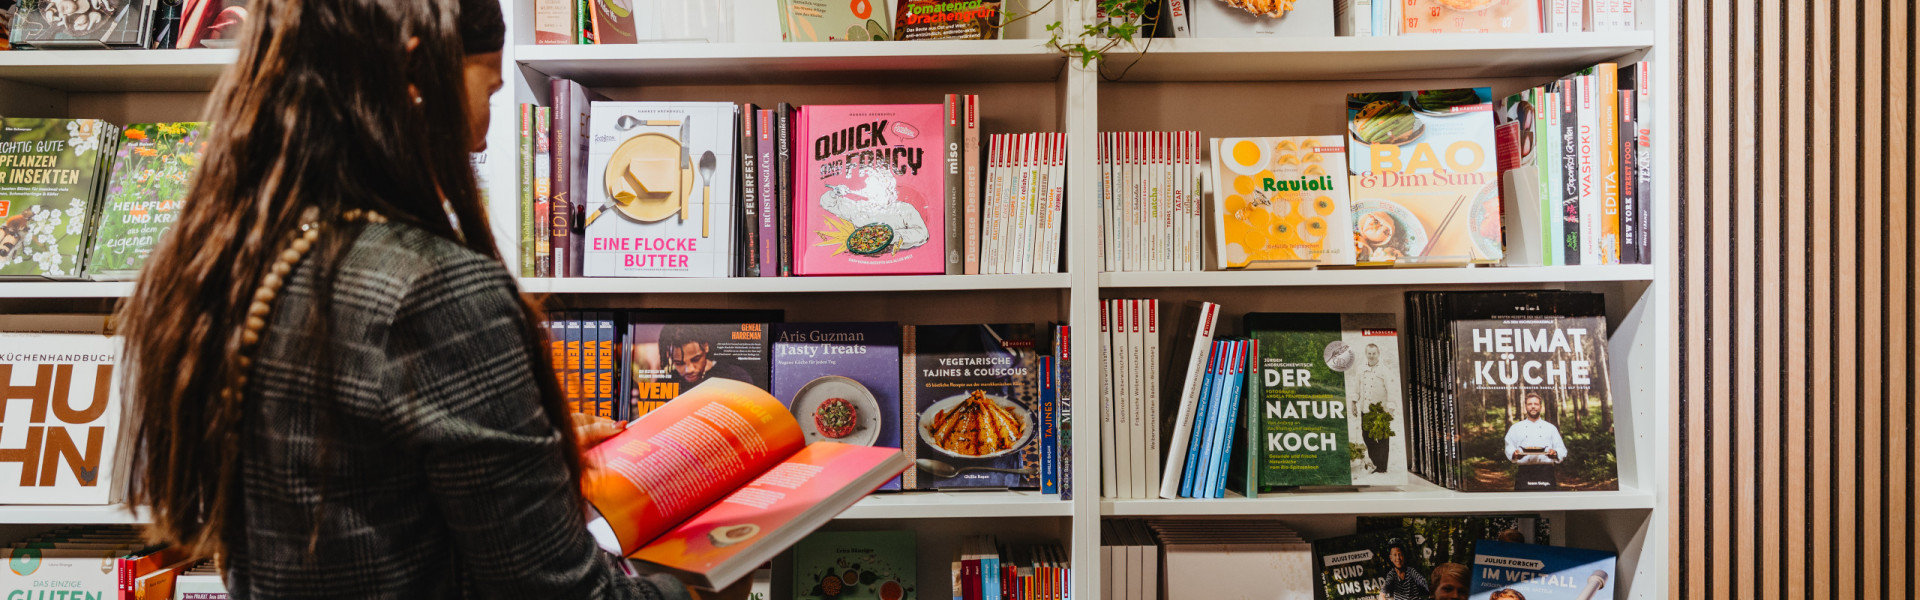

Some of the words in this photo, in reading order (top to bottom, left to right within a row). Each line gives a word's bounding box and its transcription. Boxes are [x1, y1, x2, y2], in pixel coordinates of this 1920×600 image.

[908, 0, 982, 14] Tomatenrot
[908, 7, 994, 24] Drachengrün
[36, 140, 64, 152] GUTE
[556, 129, 564, 156] inspiriert
[779, 117, 788, 159] Kastanien
[815, 120, 888, 161] QUICK
[1639, 129, 1650, 147] BBQ
[0, 155, 57, 167] PFLANZEN
[846, 147, 924, 179] FANCY
[947, 142, 958, 174] miso
[1370, 141, 1484, 175] BAO
[1581, 125, 1591, 197] WASHOKU
[1639, 151, 1650, 183] TEXAS
[9, 169, 80, 184] INSEKTEN
[745, 154, 755, 215] FEUERFEST
[1263, 176, 1333, 191] Ravioli
[1360, 171, 1377, 188] &
[1382, 171, 1428, 187] Dim
[1432, 168, 1485, 186] Sum
[762, 153, 771, 227] FRÜHSTÜCKSGLÜCK
[967, 166, 976, 212] Desserts
[1605, 171, 1617, 215] EDITA
[1149, 188, 1157, 218] matcha
[123, 214, 150, 223] UND
[553, 192, 567, 237] EDITA
[1018, 202, 1026, 229] chutneys
[107, 234, 153, 254] eigenen
[594, 238, 629, 250] EINE
[635, 238, 696, 251] FLOCKE
[967, 217, 976, 262] Ducasse
[624, 254, 688, 268] BUTTER
[732, 332, 761, 340] HARREMAN
[742, 323, 761, 331] GENEAL
[780, 331, 806, 342] Aris
[810, 330, 864, 342] Guzman
[1472, 328, 1586, 352] HEIMAT
[0, 353, 114, 361] KÜCHENHANDBUCH
[568, 341, 579, 369] VENI
[584, 340, 595, 369] VENI
[600, 340, 612, 369] VENI
[779, 344, 818, 358] Tasty
[821, 344, 866, 354] Treats
[974, 368, 1027, 376] COUSCOUS
[1264, 369, 1311, 387] DER
[1474, 353, 1590, 385] KÜCHE
[0, 364, 114, 424] HU
[584, 372, 595, 398] VIDI
[600, 372, 612, 398] VIDI
[638, 382, 680, 399] VENI
[1062, 395, 1070, 423] MEZE
[1266, 400, 1344, 419] NATUR
[1267, 432, 1336, 451] KOCH
[1333, 565, 1364, 580] RUND
[1509, 560, 1538, 568] FORSCHT
[1337, 581, 1361, 595] UMS
[1363, 577, 1386, 593] RAD
[1483, 568, 1500, 580] IM
[1506, 570, 1576, 588] WELTALL
